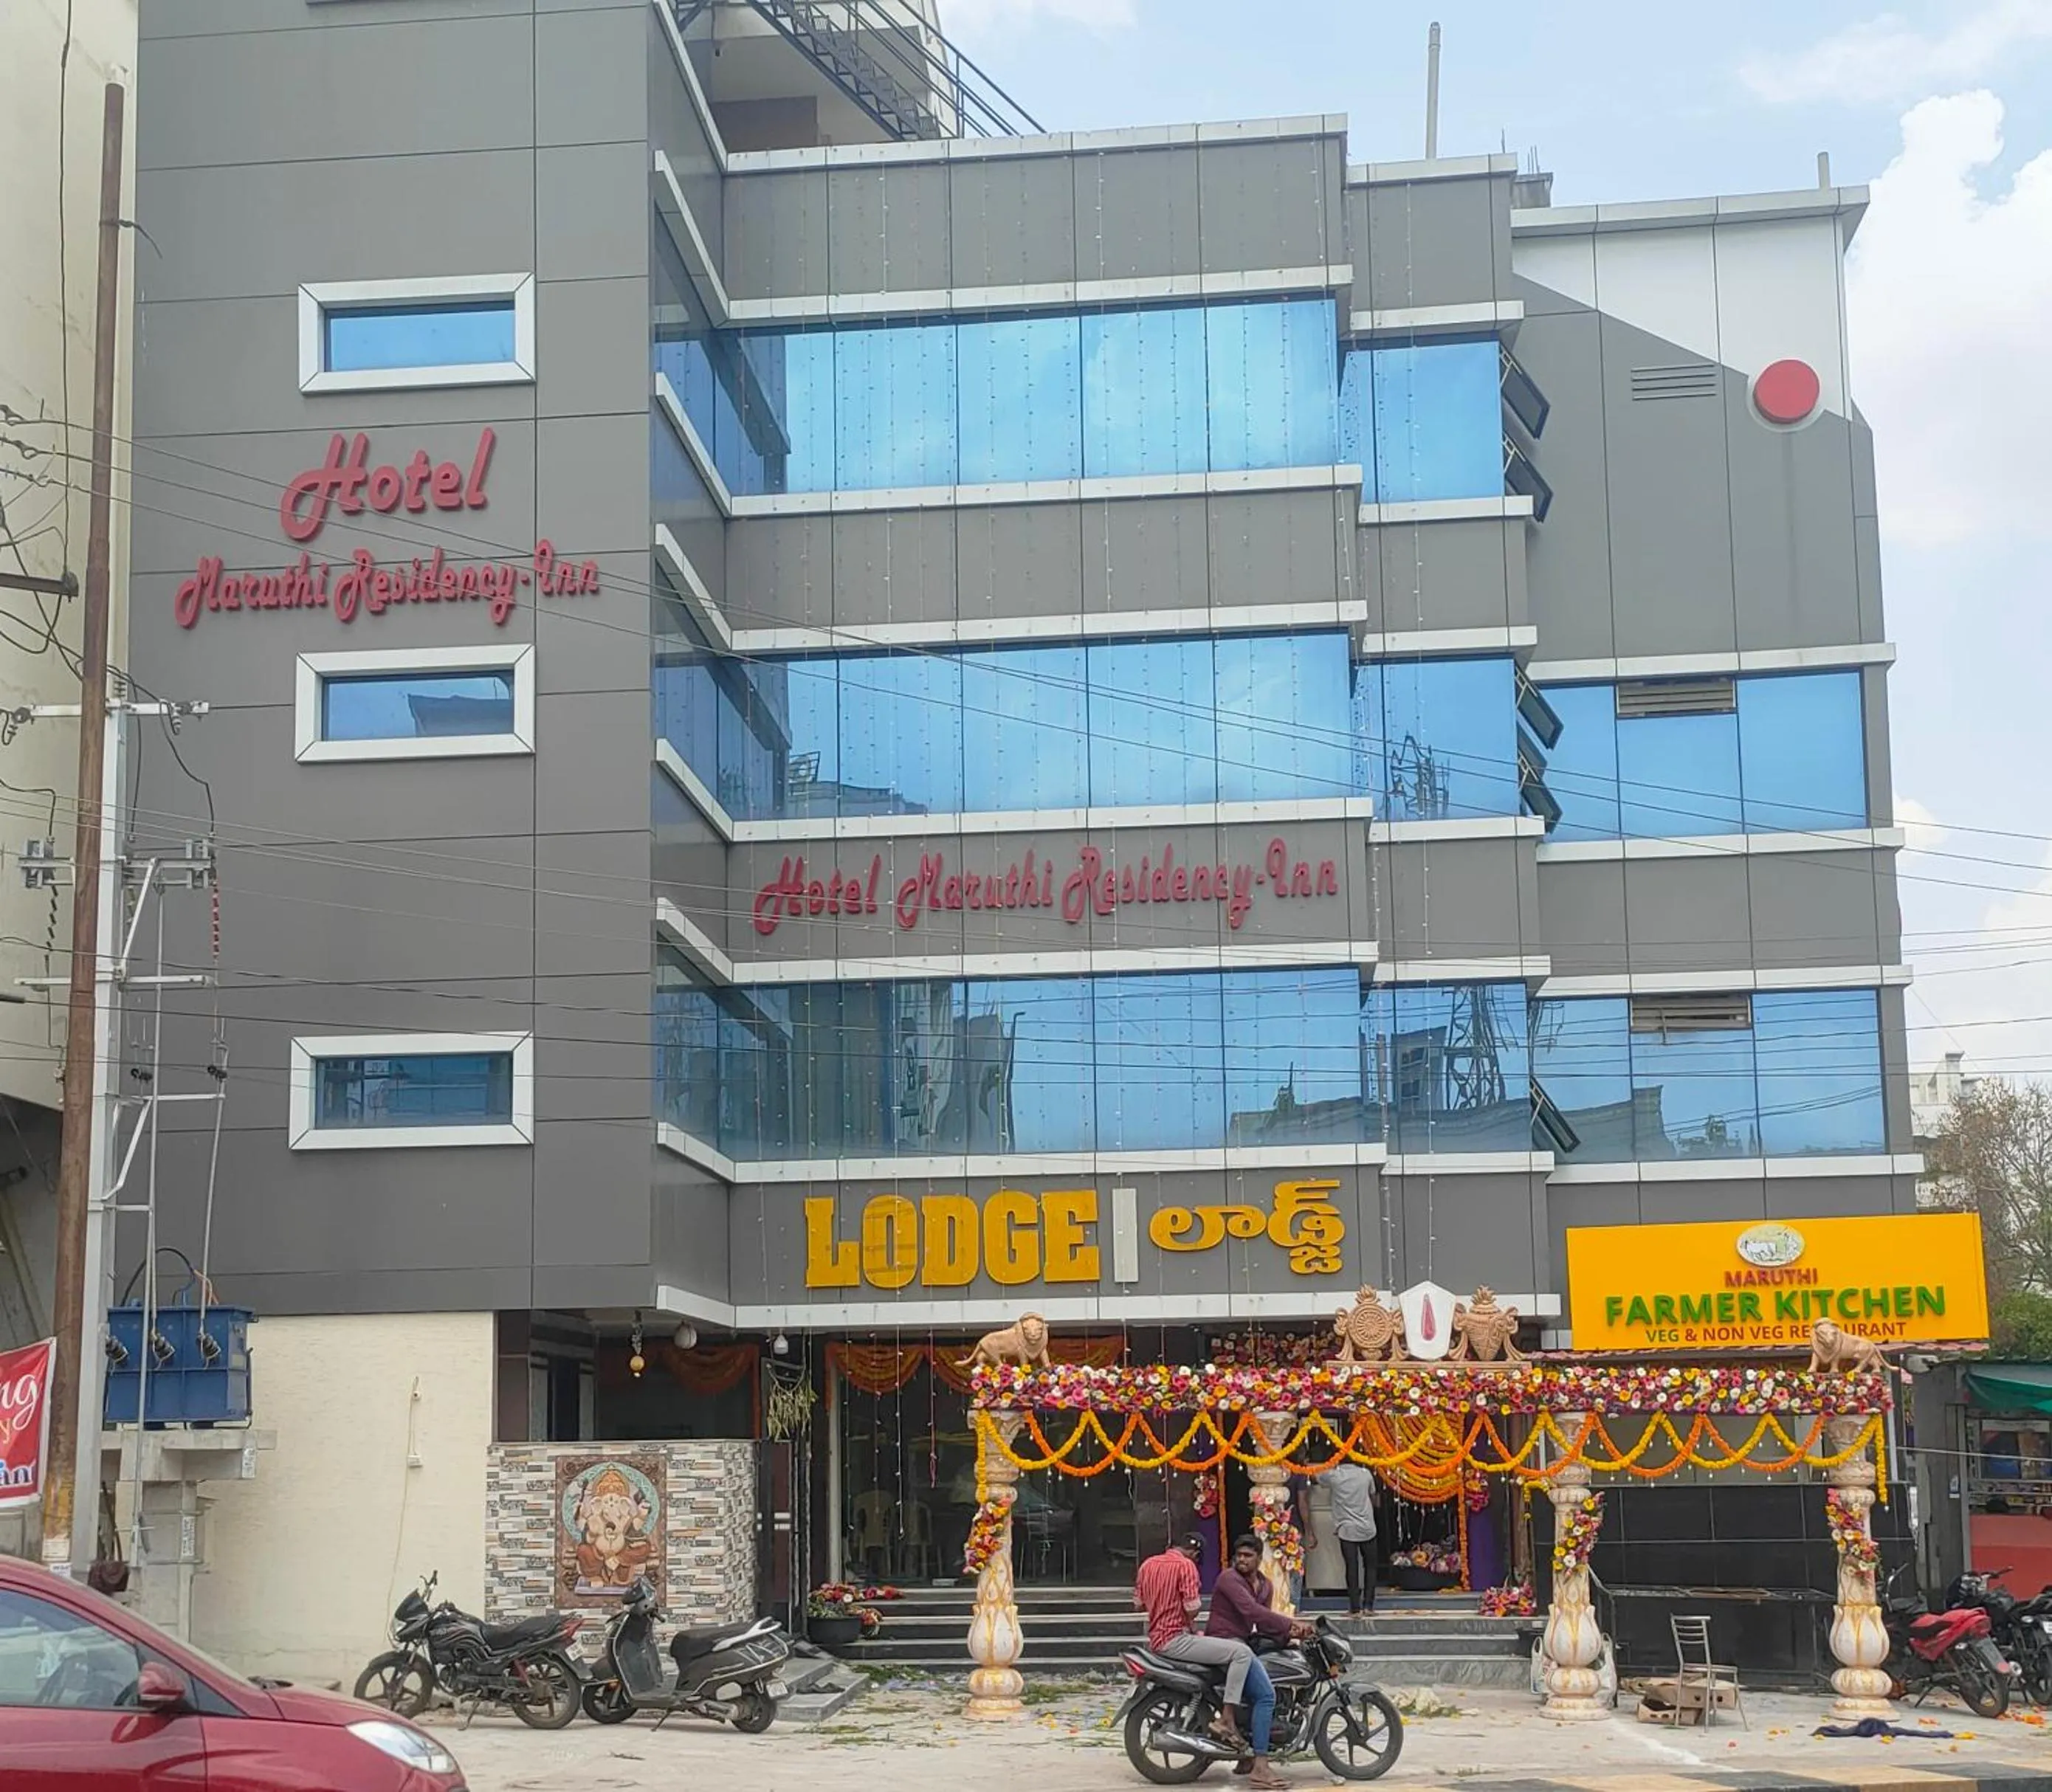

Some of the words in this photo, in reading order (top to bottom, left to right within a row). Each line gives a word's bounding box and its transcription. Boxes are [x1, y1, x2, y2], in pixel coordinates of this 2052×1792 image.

[280, 427, 495, 542] Hotel
[173, 551, 328, 629] Maruthi
[753, 854, 882, 935] Hotel
[896, 849, 1053, 930] Maruthi
[803, 1189, 1101, 1290] LODGE
[1724, 1267, 1818, 1288] MARUTHI
[1605, 1290, 1763, 1326] FARMER
[1775, 1285, 1946, 1320] KITCHEN
[1645, 1329, 1679, 1343] VEG
[1684, 1328, 1698, 1342] &
[1702, 1326, 1745, 1341] NON
[1749, 1325, 1784, 1341] VEG
[1789, 1322, 1907, 1340] REURANT
